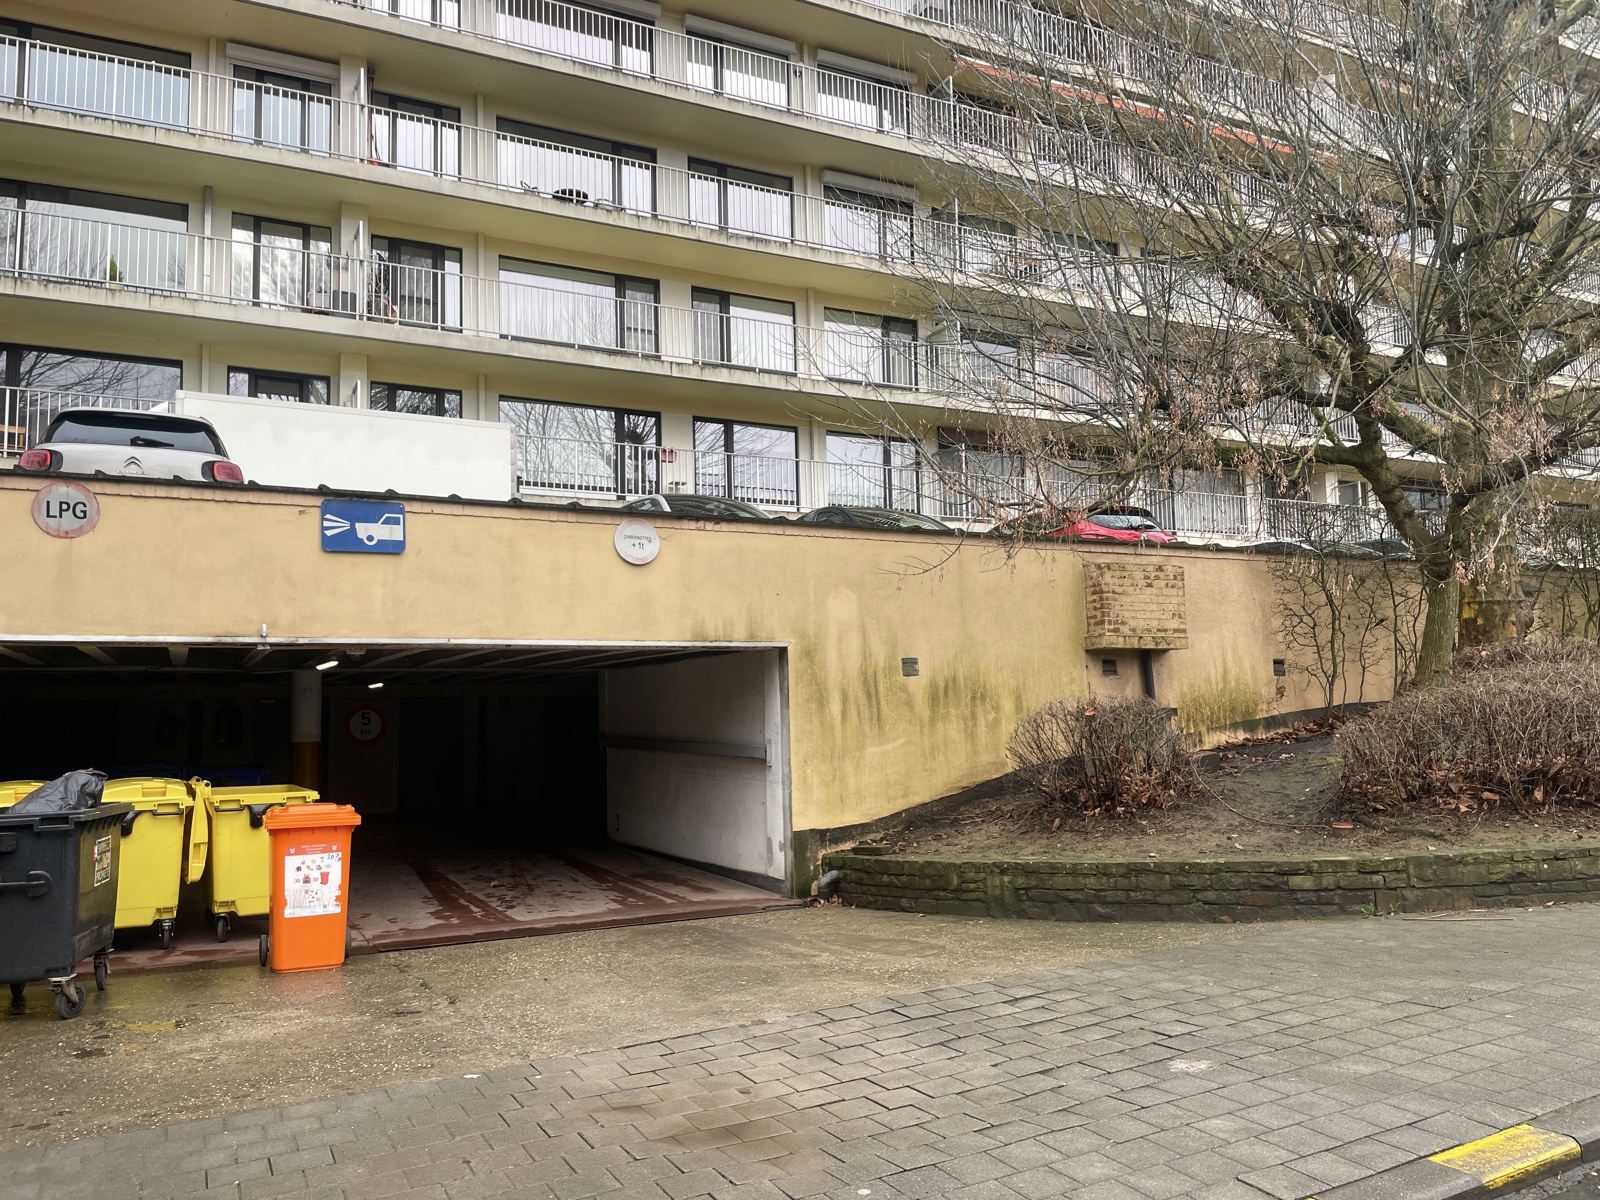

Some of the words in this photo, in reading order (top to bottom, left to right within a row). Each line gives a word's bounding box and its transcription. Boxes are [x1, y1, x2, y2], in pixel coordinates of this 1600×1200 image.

[46, 500, 87, 519] LPG
[361, 711, 371, 726] 5
[360, 728, 372, 736] km
